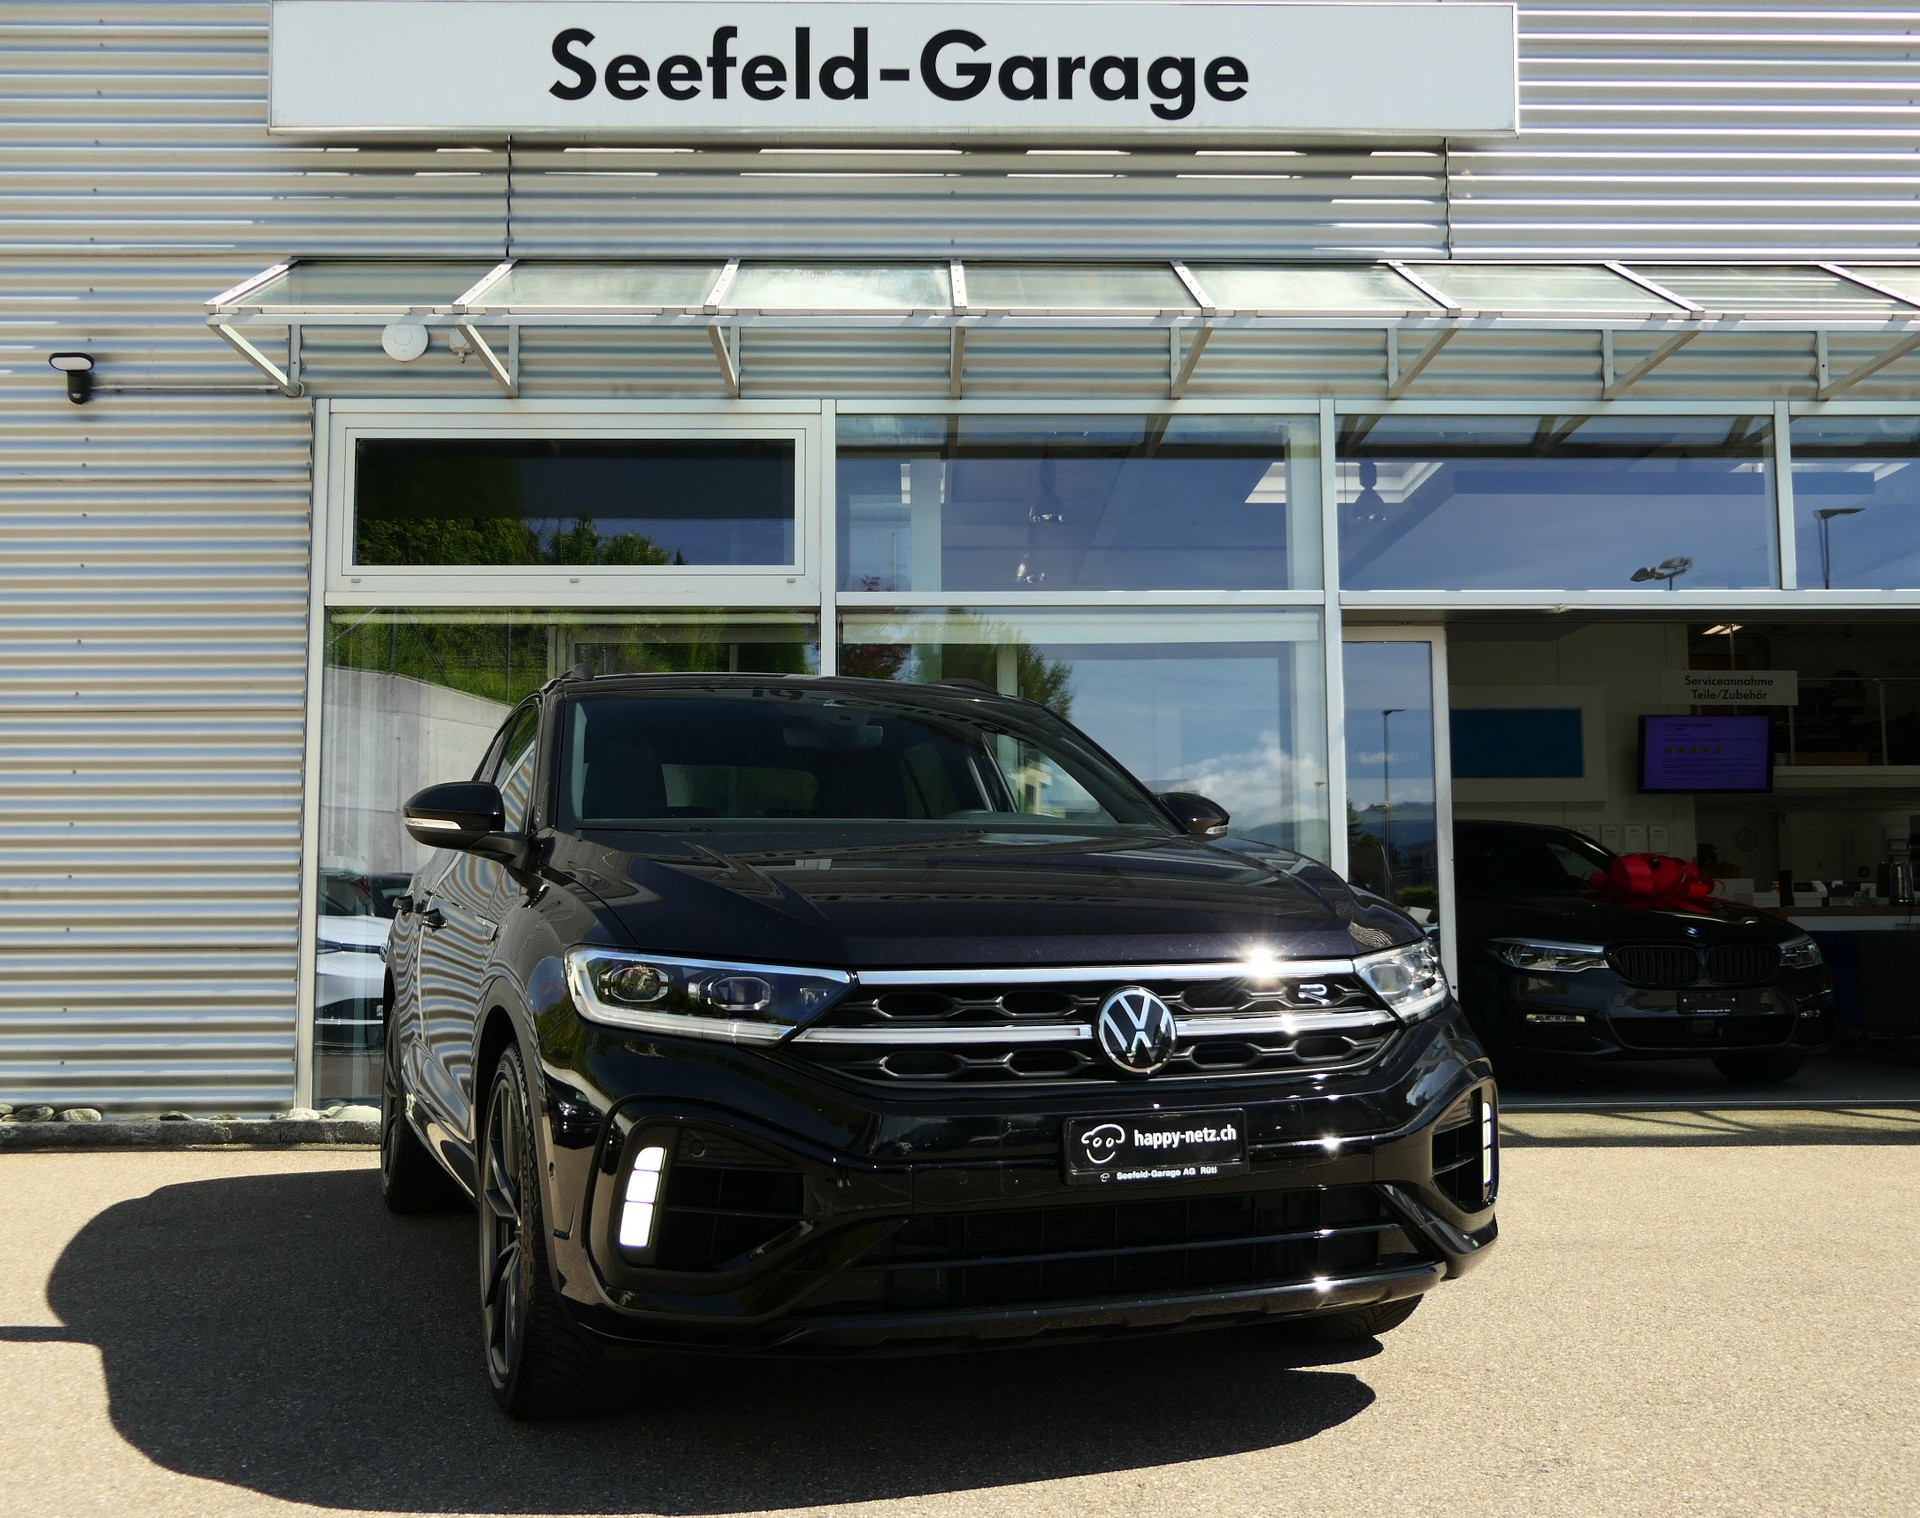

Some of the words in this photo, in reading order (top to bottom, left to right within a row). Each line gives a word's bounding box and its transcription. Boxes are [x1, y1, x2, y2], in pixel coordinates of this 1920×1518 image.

[549, 26, 1249, 121] Seefeld-Garage
[1684, 675, 1774, 687] Serviceannahme
[1691, 688, 1768, 701] Teile/Zubehör
[1133, 1124, 1237, 1149] happy-netz.ch
[1116, 1169, 1182, 1181] Seefeld-Garage
[1183, 1167, 1197, 1176] AG
